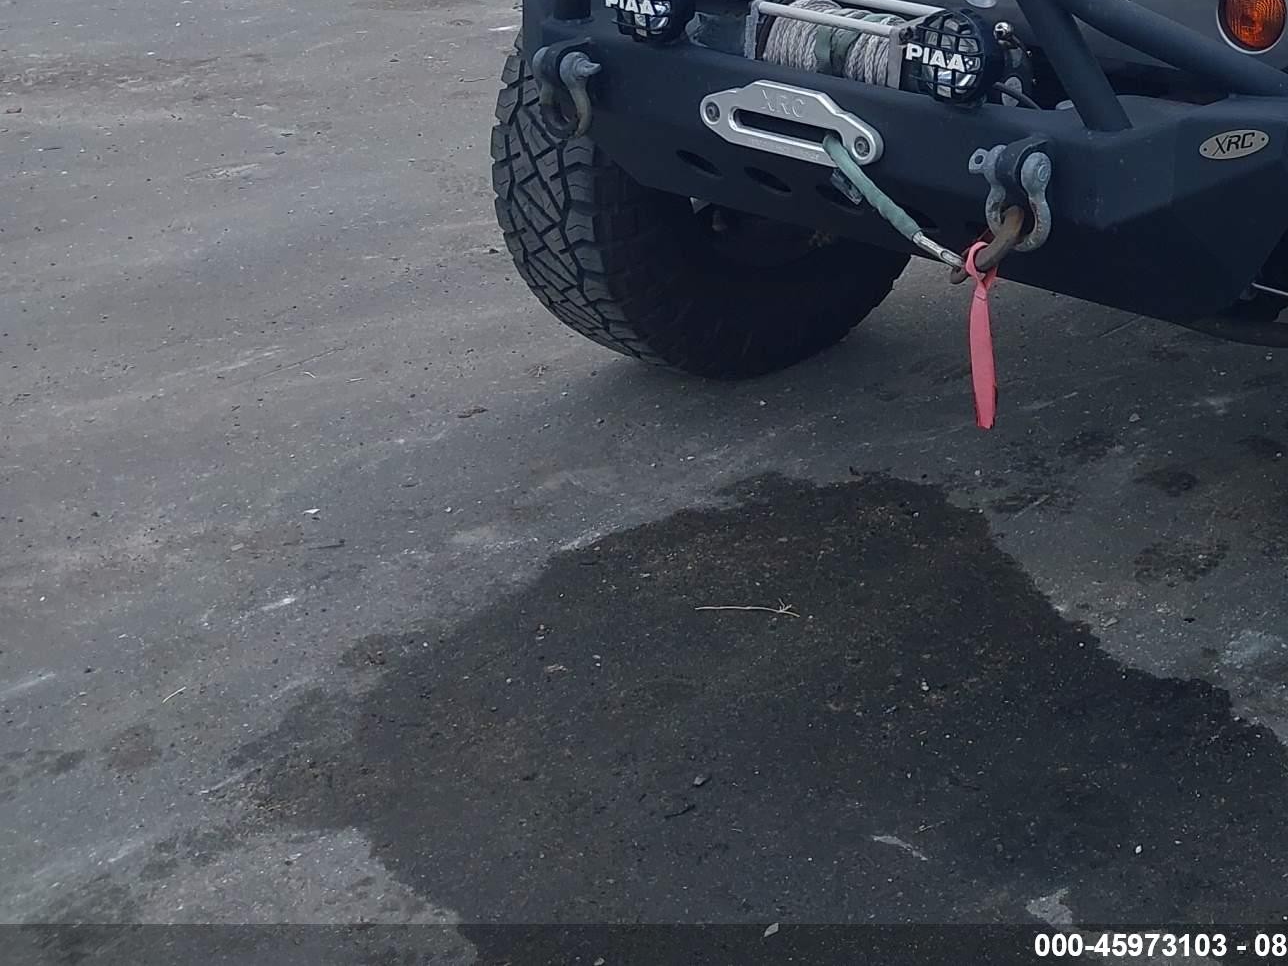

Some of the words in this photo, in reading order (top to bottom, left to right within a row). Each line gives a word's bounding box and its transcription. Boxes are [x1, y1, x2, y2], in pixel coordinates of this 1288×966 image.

[905, 42, 966, 73] PIAA
[760, 89, 806, 118] XRC
[1212, 132, 1255, 156] XRC
